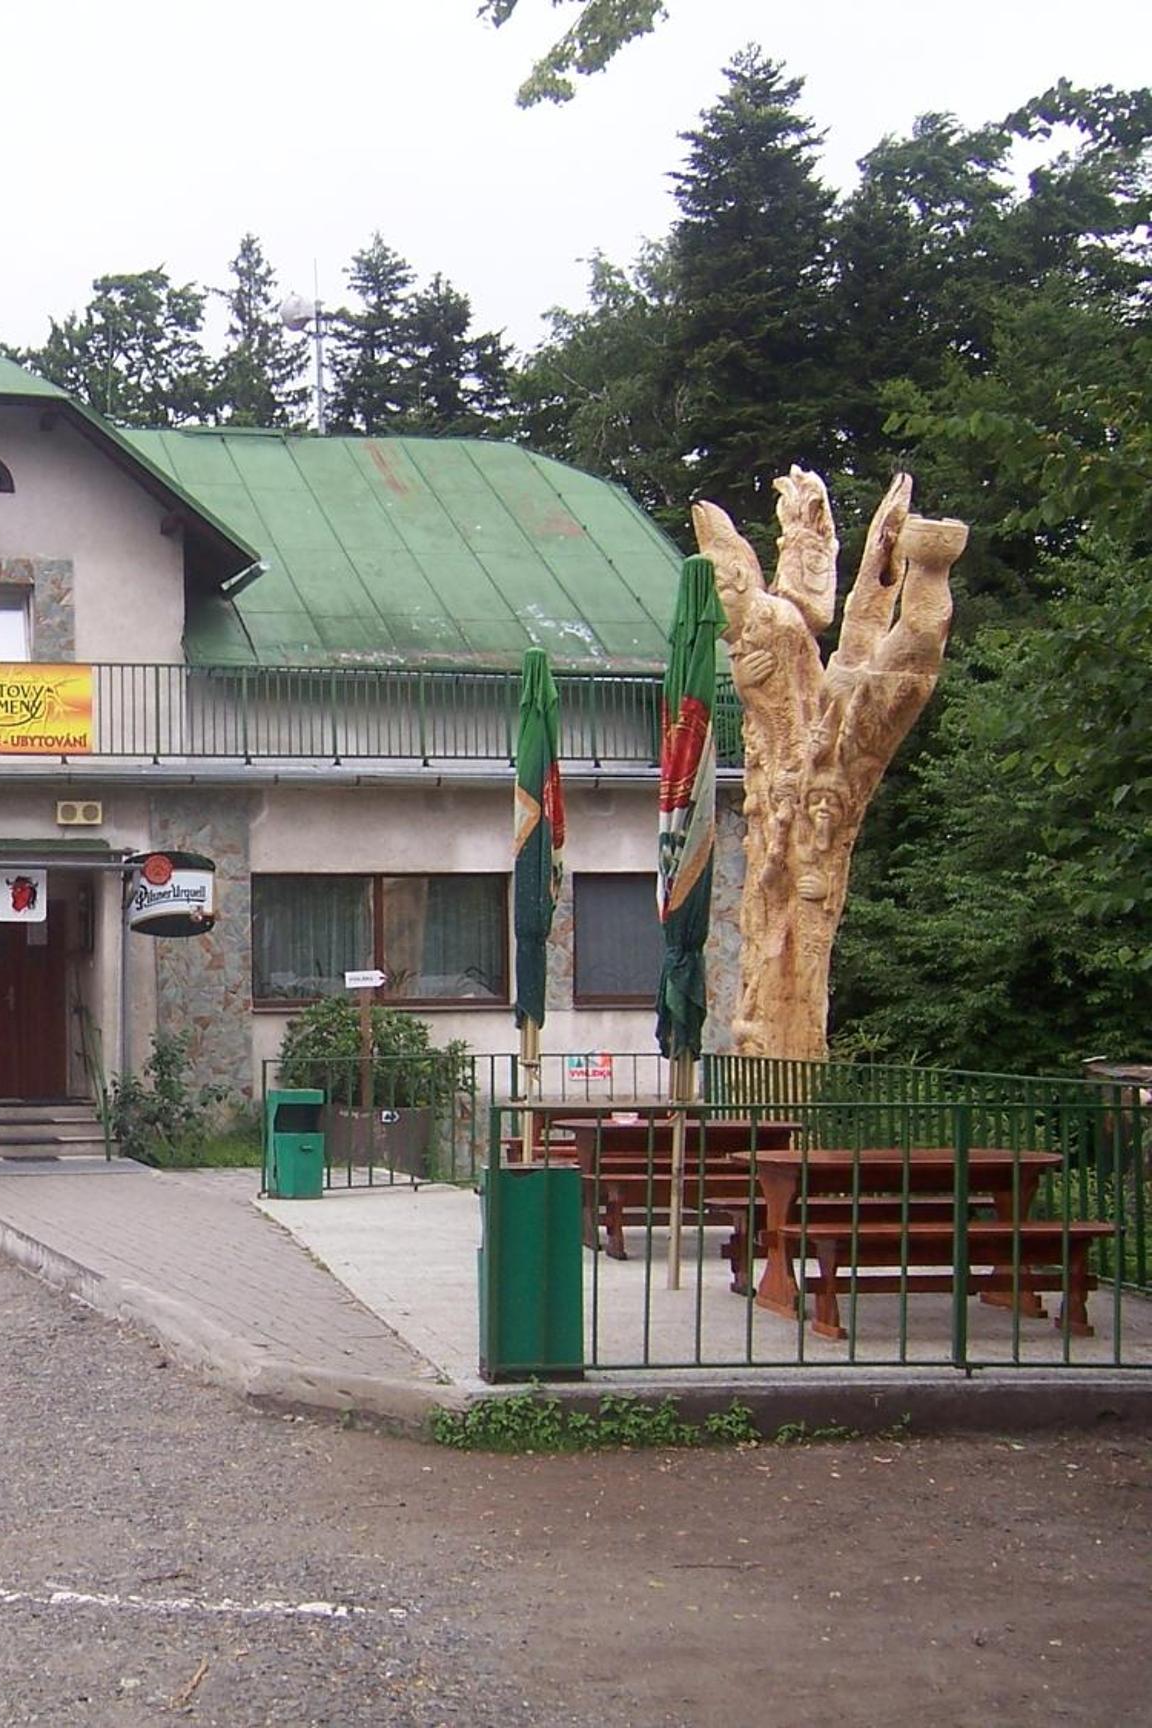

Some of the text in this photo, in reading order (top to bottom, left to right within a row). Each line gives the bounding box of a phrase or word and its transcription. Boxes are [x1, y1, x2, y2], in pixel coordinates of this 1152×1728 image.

[10, 732, 87, 749] UBYTOVÁNÍ
[134, 883, 207, 911] Pilsner Urquell
